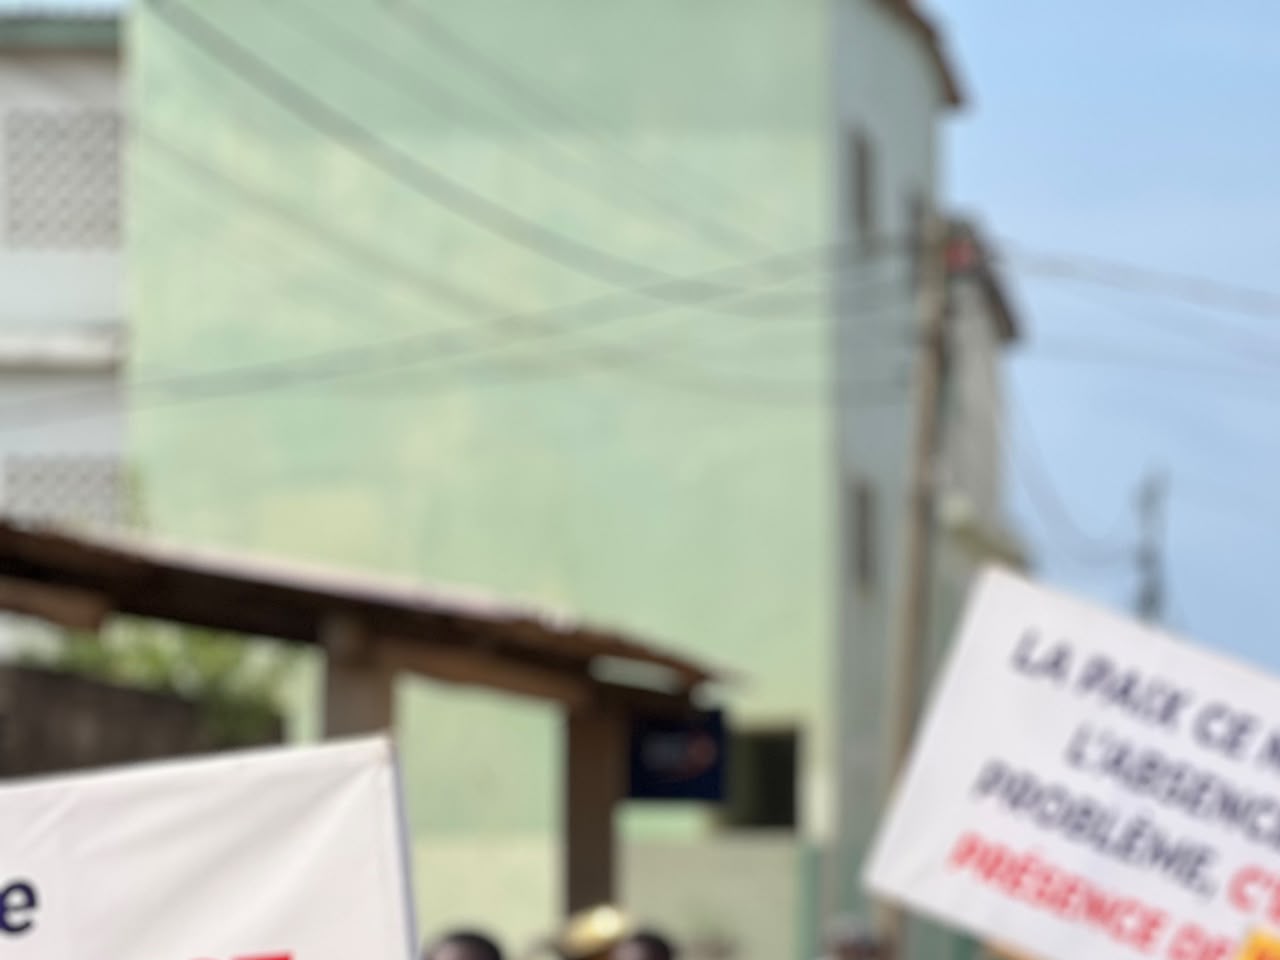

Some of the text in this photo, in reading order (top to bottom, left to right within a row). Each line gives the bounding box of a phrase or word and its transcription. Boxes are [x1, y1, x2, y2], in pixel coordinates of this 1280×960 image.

[1012, 633, 1072, 684] LA
[1077, 657, 1188, 727] PAIX
[1193, 704, 1257, 759] CE
